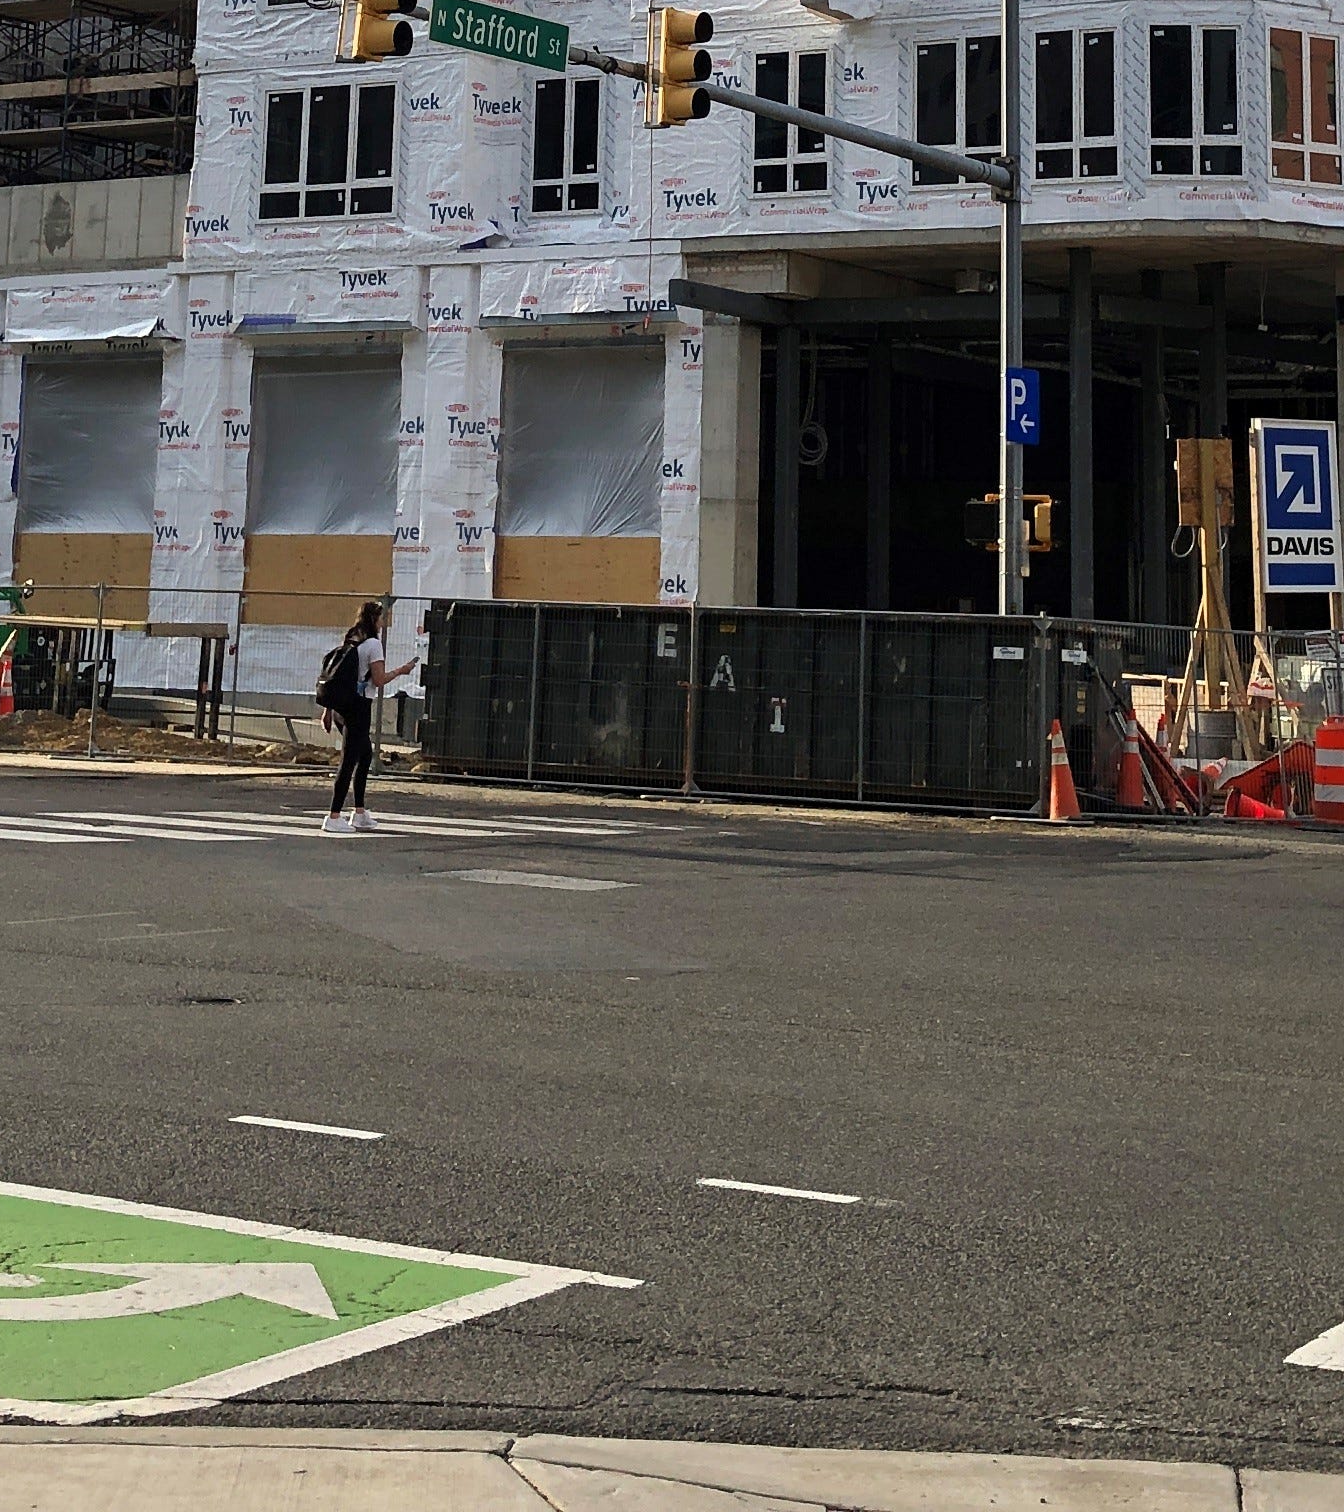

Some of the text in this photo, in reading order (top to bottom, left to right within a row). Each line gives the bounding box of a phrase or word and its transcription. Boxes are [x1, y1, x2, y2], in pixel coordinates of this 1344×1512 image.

[437, 7, 561, 58] N Stafford St
[663, 188, 717, 212] Tyvek
[429, 203, 474, 224] Tyvek
[185, 215, 229, 237] Tyvek
[339, 270, 387, 291] Tyvek
[1010, 378, 1027, 421] P
[1267, 536, 1335, 556] DAVIS
